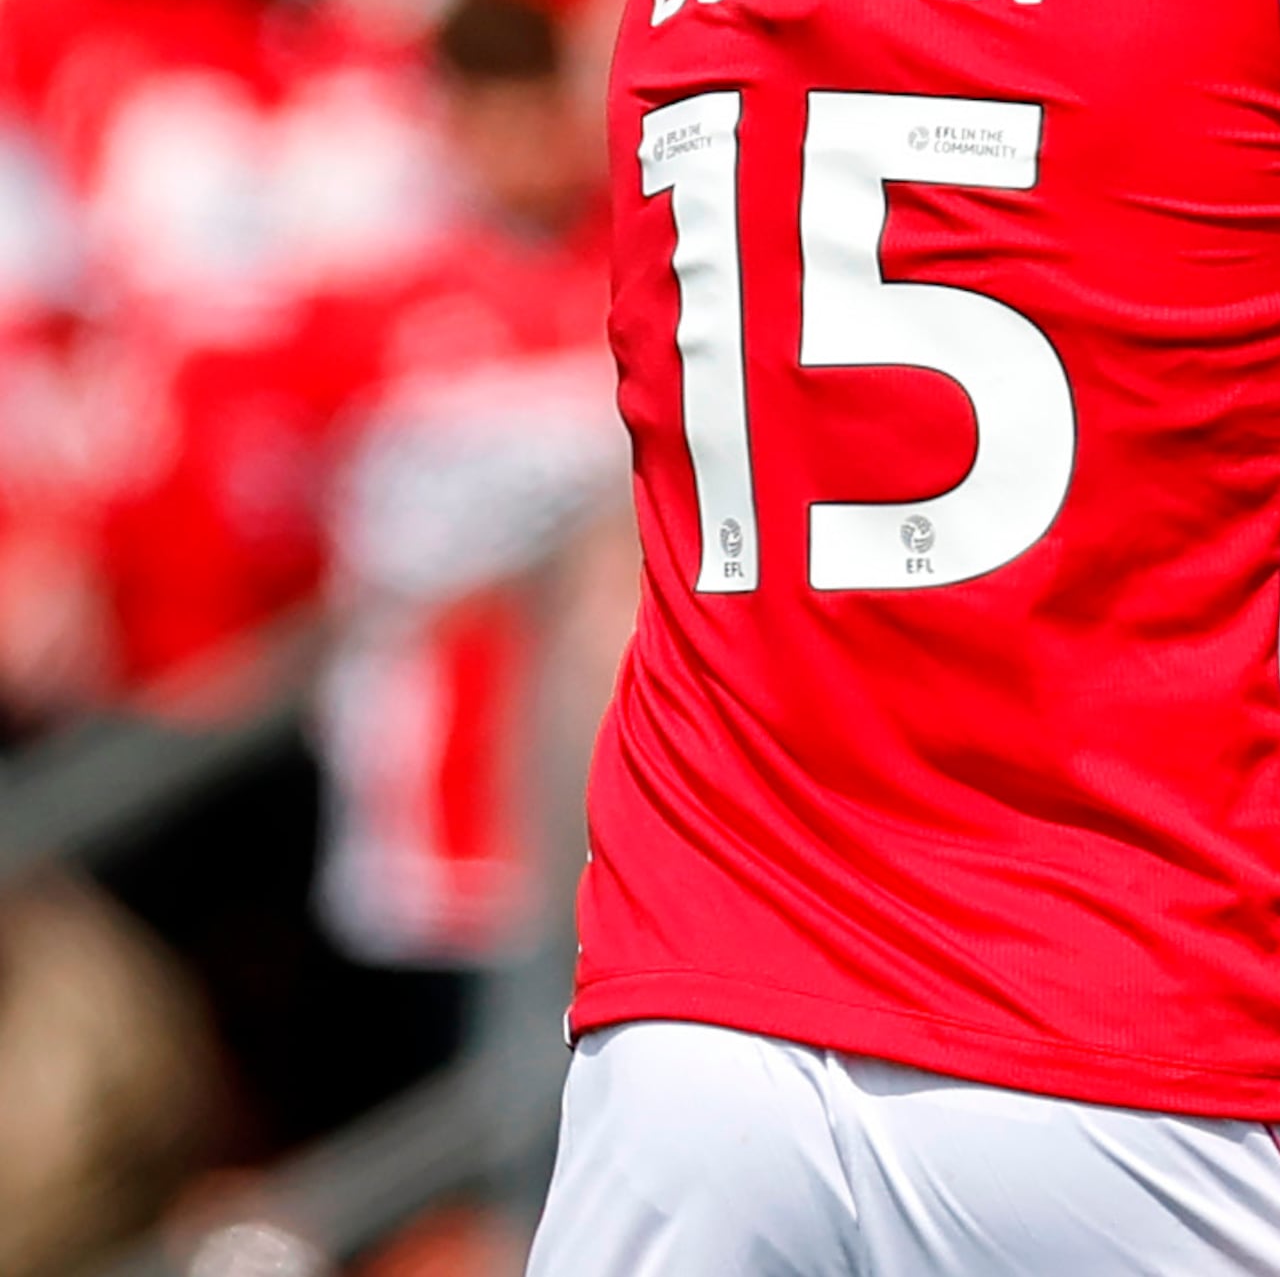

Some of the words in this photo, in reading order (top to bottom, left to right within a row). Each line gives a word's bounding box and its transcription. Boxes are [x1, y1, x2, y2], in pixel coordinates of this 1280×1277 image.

[934, 140, 1017, 159] COMMUNITY
[638, 89, 1077, 593] 15
[724, 561, 744, 578] EFL
[906, 558, 935, 574] EFL
